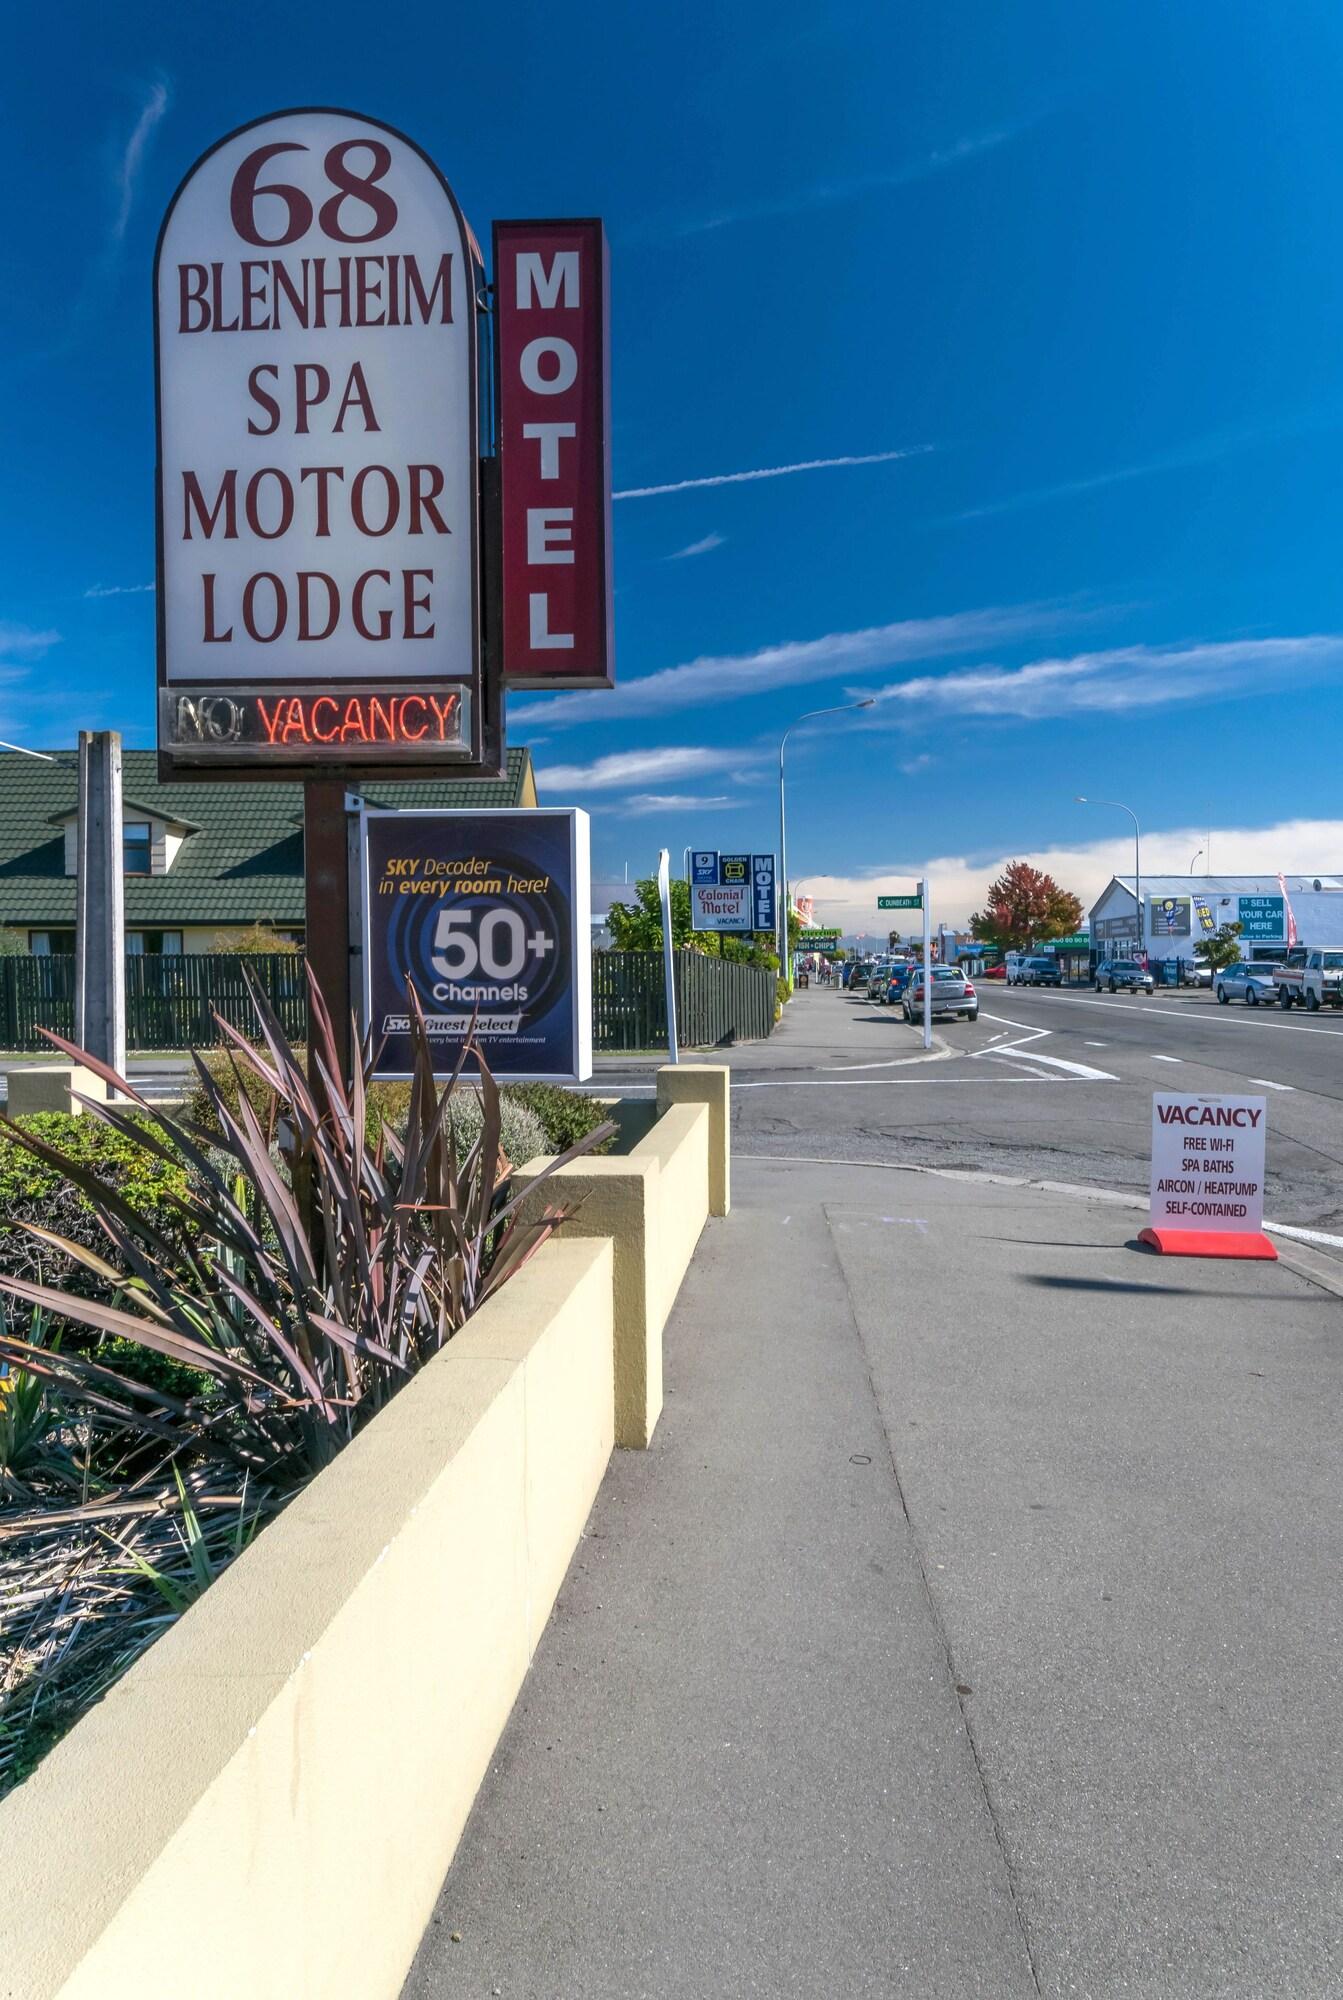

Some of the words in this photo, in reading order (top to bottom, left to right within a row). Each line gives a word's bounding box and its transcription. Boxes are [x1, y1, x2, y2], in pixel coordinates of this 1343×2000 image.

[230, 139, 399, 248] 68
[178, 253, 454, 334] BLENHEIM
[247, 361, 382, 436] SPA
[516, 251, 579, 650] MOTEL
[182, 464, 452, 540] MOTOR
[202, 568, 436, 644] LODGE
[257, 694, 457, 745] VACANCY
[385, 858, 420, 876] SKY
[424, 857, 492, 876] Decoder
[701, 856, 709, 866] 9
[379, 877, 394, 895] in
[399, 880, 450, 898] every
[454, 878, 502, 894] room
[507, 875, 549, 894] here!
[698, 888, 744, 901] Colonial
[755, 858, 773, 928] MOTEL
[702, 901, 740, 914] Motel
[1250, 899, 1272, 907] SELL
[717, 918, 745, 926] VACANCY
[1240, 910, 1263, 919] YOUR
[1265, 910, 1283, 919] CAR
[1250, 922, 1272, 930] HERE
[431, 908, 554, 980] 50+
[432, 982, 529, 1001] Channels
[424, 1018, 466, 1031] Guest
[488, 1035, 498, 1044] TV
[499, 1035, 546, 1044] entertainment
[1157, 1104, 1262, 1128] VACANCY
[1183, 1137, 1207, 1151] FREE
[1210, 1138, 1234, 1152] WI-FI
[1182, 1158, 1200, 1172] SPA
[1203, 1160, 1234, 1174] BATHS
[1157, 1179, 1195, 1193] AIRCON
[1204, 1181, 1258, 1196] HEATPUMP
[1166, 1200, 1247, 1217] SELF-CONTAINED
